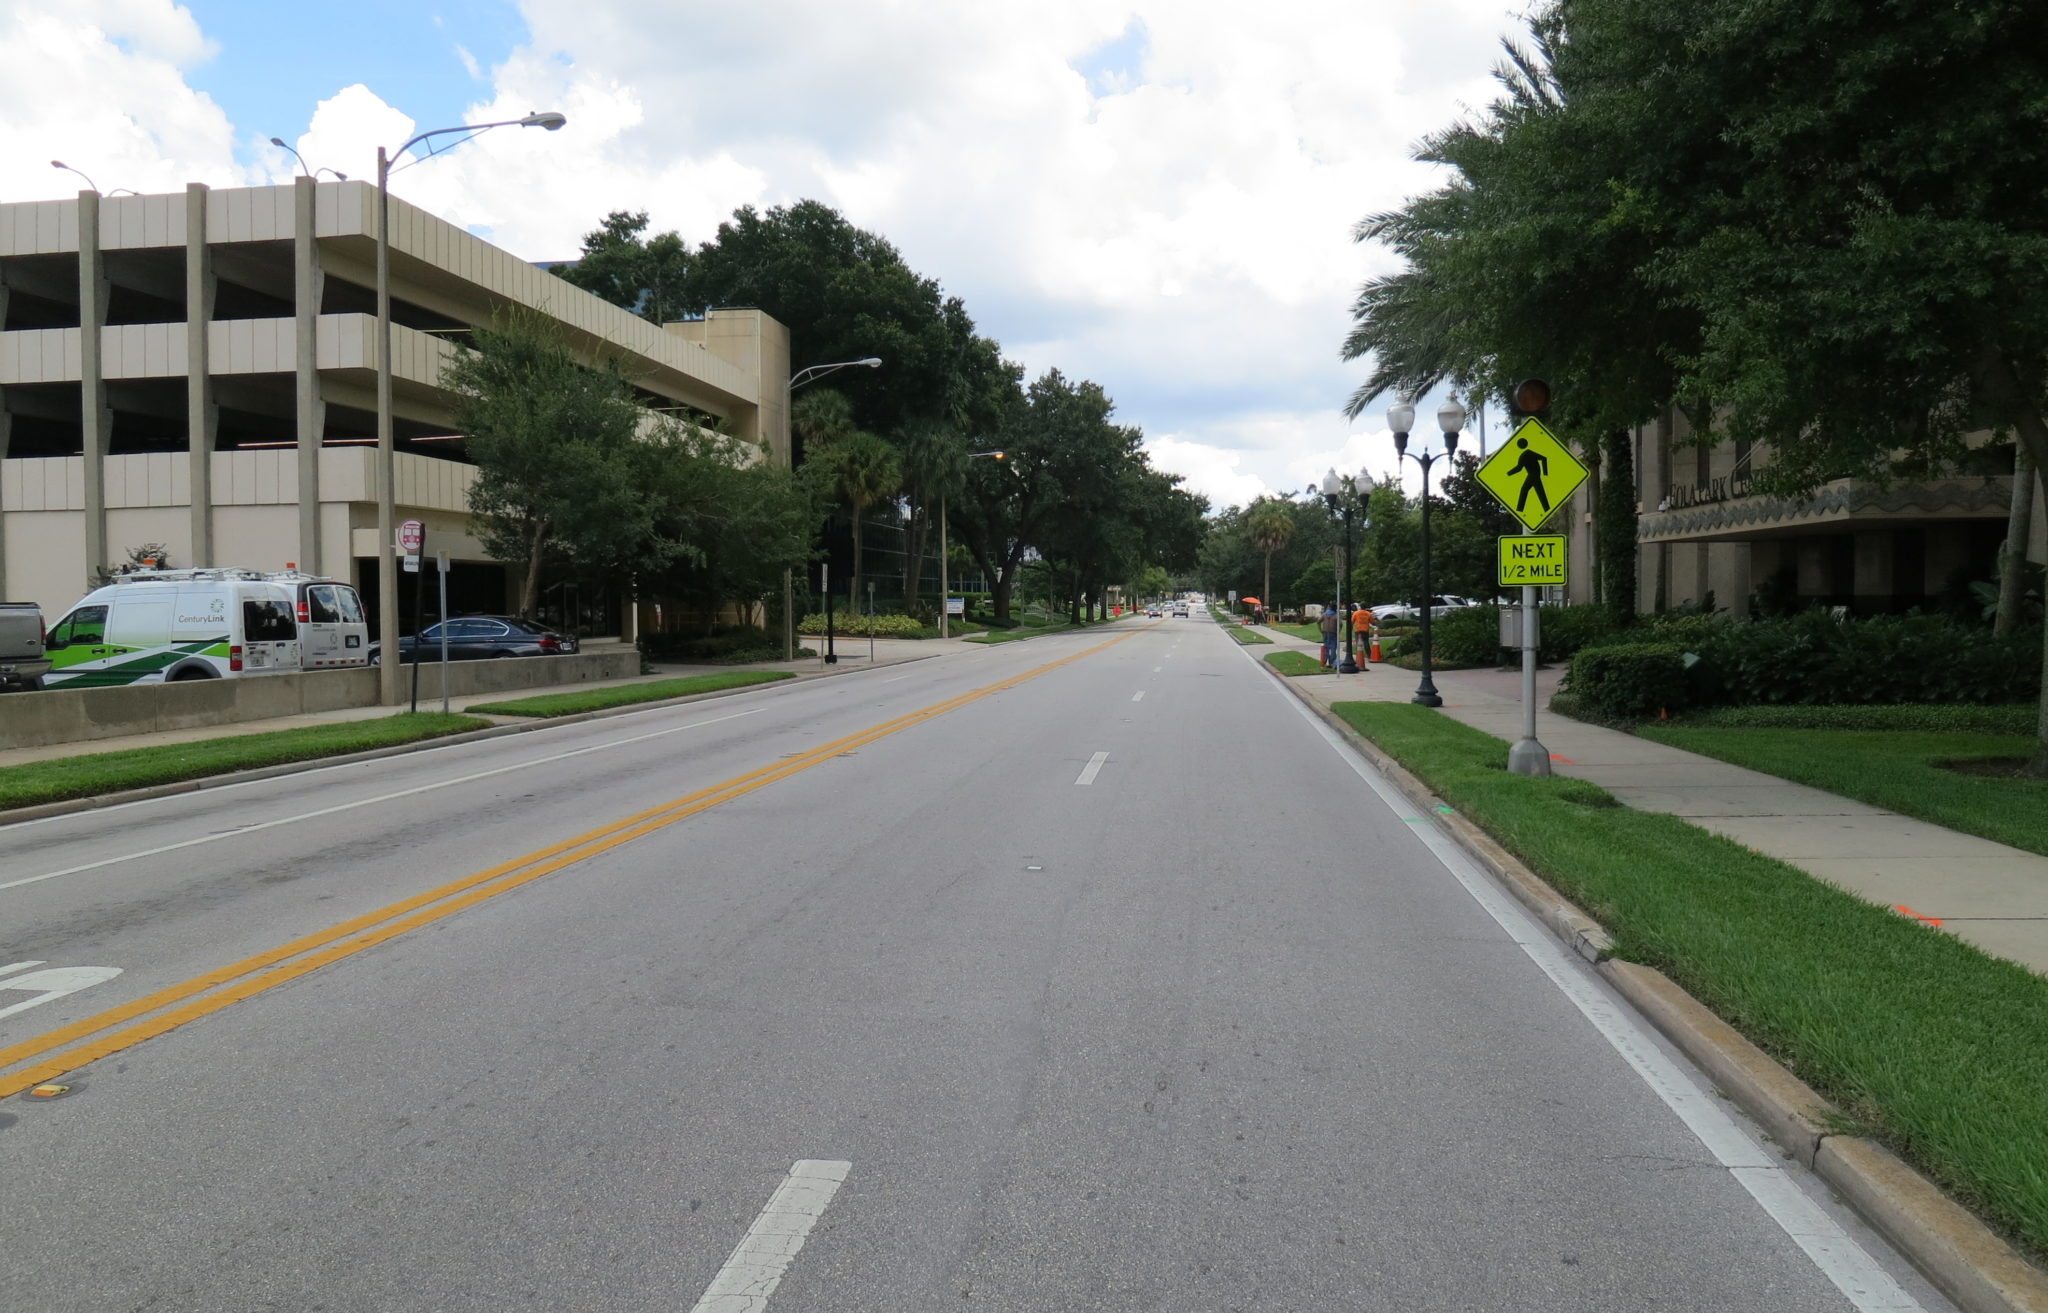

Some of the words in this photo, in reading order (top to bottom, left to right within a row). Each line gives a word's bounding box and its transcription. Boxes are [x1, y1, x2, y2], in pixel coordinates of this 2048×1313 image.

[1512, 543, 1556, 559] NEXT
[1503, 565, 1525, 578] 1/2
[1530, 564, 1563, 577] MILE
[178, 614, 226, 624] CenturyLink
